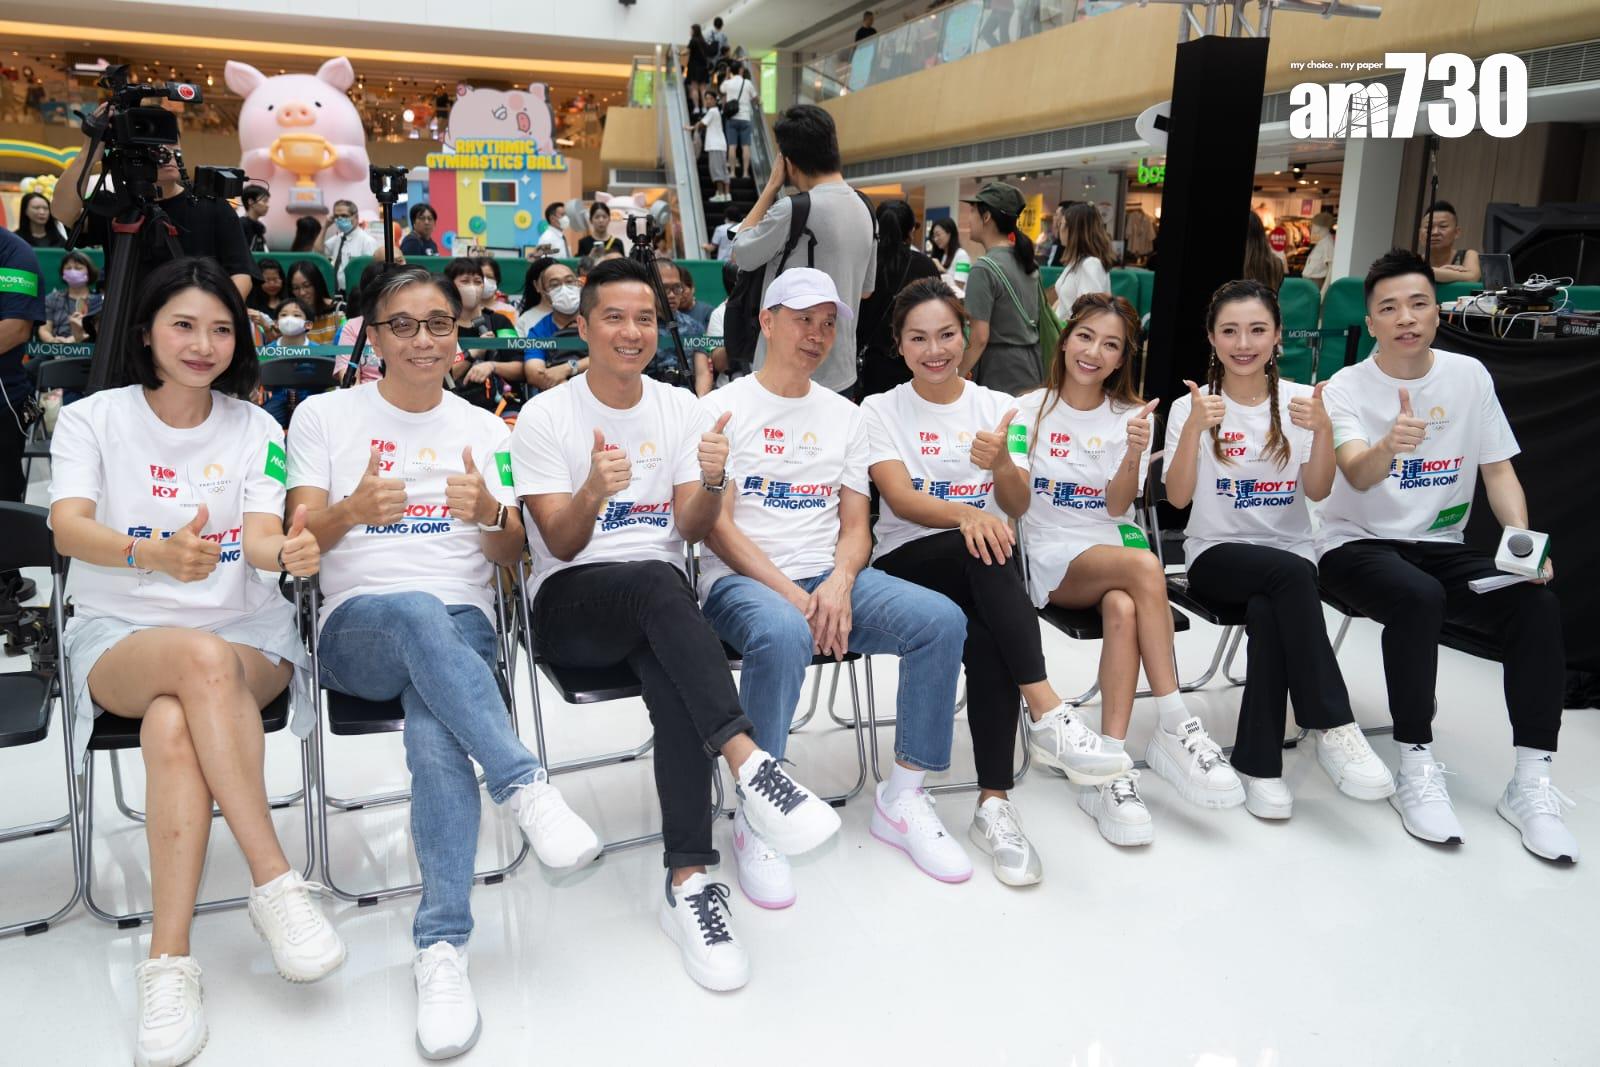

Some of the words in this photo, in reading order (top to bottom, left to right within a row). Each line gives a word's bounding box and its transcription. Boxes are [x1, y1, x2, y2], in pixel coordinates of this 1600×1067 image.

[456, 139, 537, 155] RHYTHMIC
[426, 153, 523, 170] GYMNASTICS
[526, 154, 567, 171] BALL
[28, 343, 91, 355] MOSTown
[507, 339, 557, 349] MOSTown
[256, 346, 311, 356] MOSTown
[764, 444, 785, 455] HOY
[921, 446, 941, 456] HOY
[1050, 448, 1069, 457] HOY
[1226, 447, 1247, 457] HOY
[1422, 460, 1451, 472] HOY
[949, 485, 978, 496] HOY
[979, 481, 995, 494] TV
[1254, 481, 1282, 492] HOY
[1399, 478, 1431, 490] HONG
[152, 485, 179, 498] HOY
[789, 484, 819, 495] HOY
[821, 485, 833, 497] TV
[1074, 486, 1103, 497] HOY
[630, 502, 661, 513] HOY
[763, 498, 798, 510] HONG
[799, 498, 827, 509] KONG
[1053, 499, 1083, 509] HONG
[1085, 500, 1107, 509] KON
[1234, 497, 1262, 509] HONG
[1263, 495, 1295, 506] KONG
[366, 523, 409, 535] HONG
[411, 522, 451, 534] KONG
[602, 519, 637, 531] HONG
[639, 516, 669, 527] KONG
